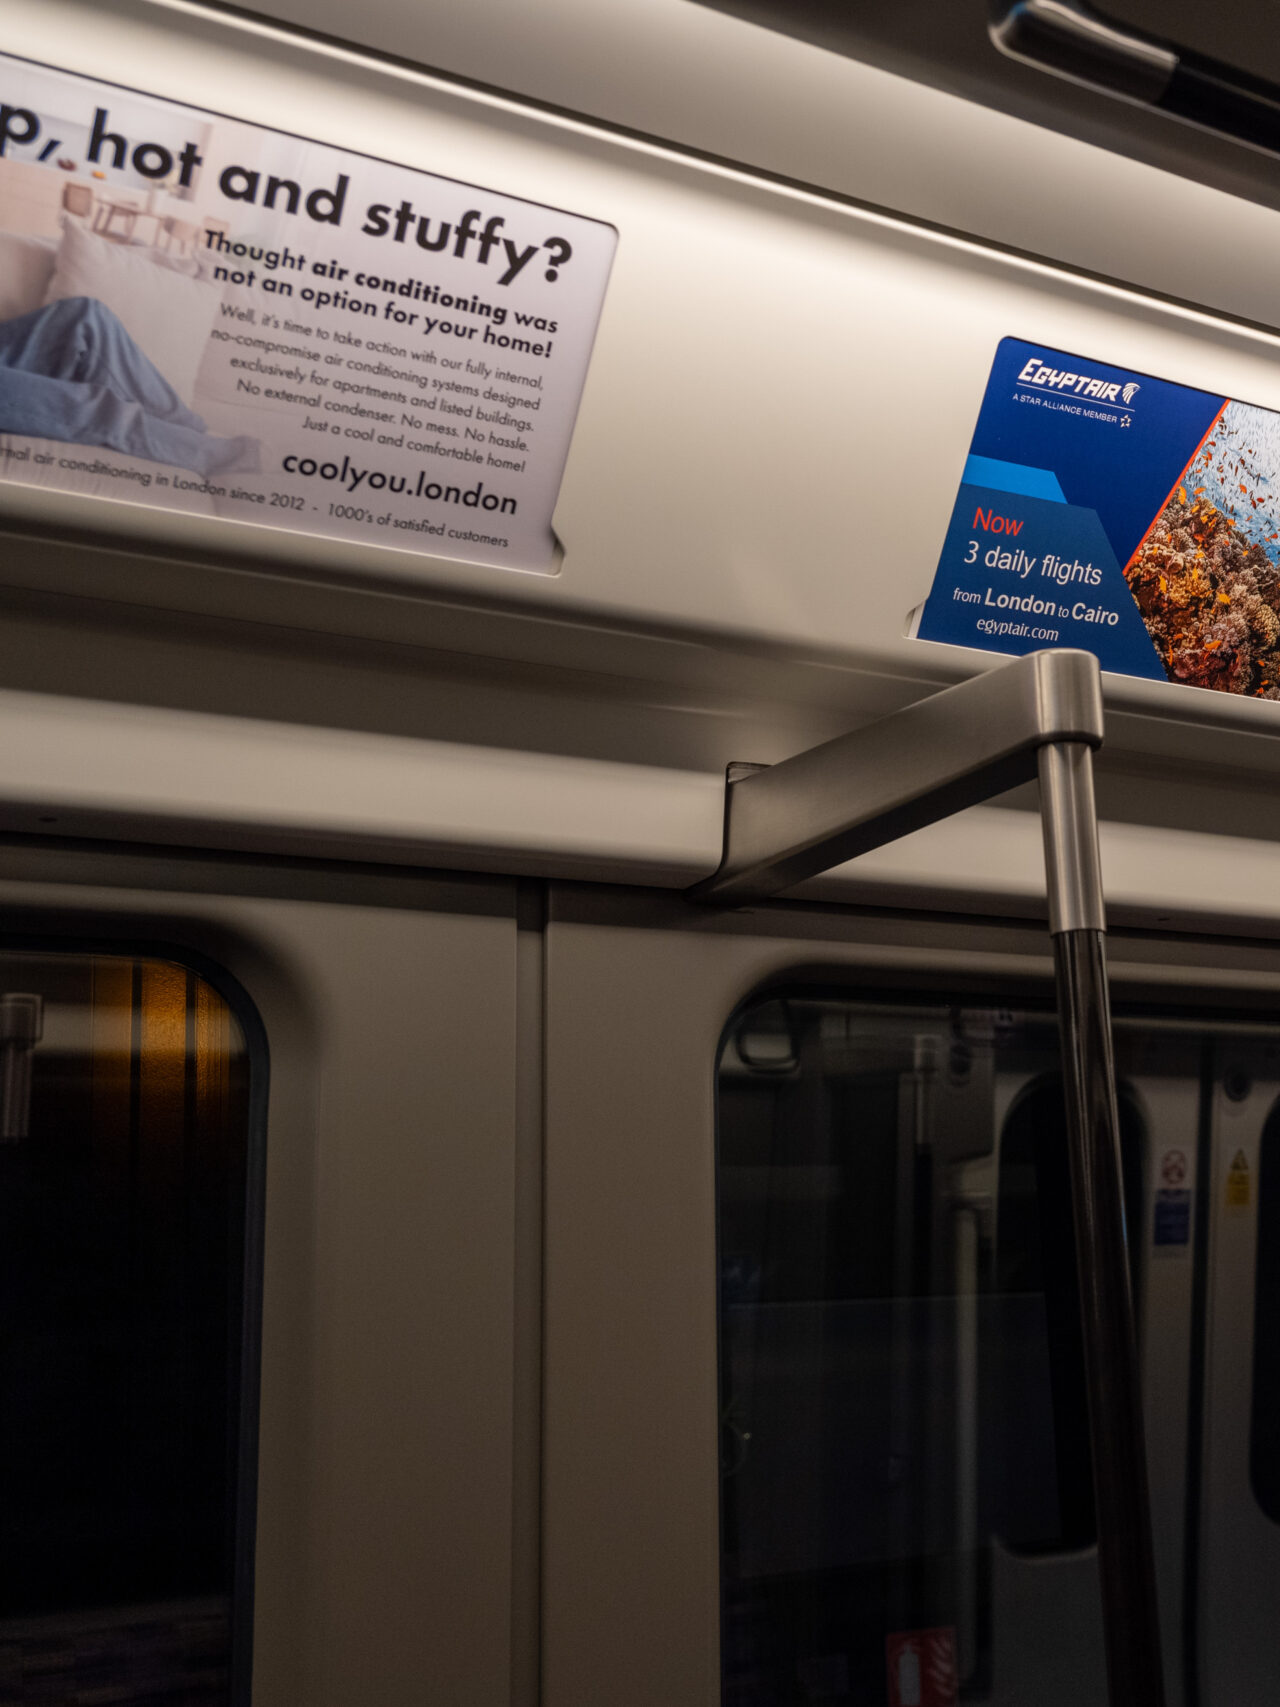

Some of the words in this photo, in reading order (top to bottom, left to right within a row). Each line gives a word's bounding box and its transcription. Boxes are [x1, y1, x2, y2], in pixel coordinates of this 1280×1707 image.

[87, 107, 203, 187] hot
[219, 164, 350, 226] and
[361, 200, 573, 287] stuffy?
[205, 229, 307, 270] Thought
[312, 260, 349, 280] air
[354, 272, 507, 326] conditioning
[515, 311, 558, 334] was
[213, 266, 256, 287] not
[262, 278, 293, 297] an
[300, 288, 377, 317] option
[384, 301, 419, 326] for
[423, 317, 478, 340] your
[483, 325, 553, 358] home!
[210, 328, 321, 362] no-compromise
[324, 354, 343, 366] air
[346, 359, 428, 389] conditioning
[431, 377, 480, 398] systems
[482, 387, 541, 410] designed
[220, 303, 256, 325] Well,
[283, 319, 313, 337] time
[316, 326, 330, 341] to
[333, 331, 363, 348] take
[365, 340, 407, 358] action
[411, 350, 437, 365] with
[440, 357, 463, 370] our
[466, 359, 492, 379] fully
[494, 368, 544, 391] internal,
[1017, 358, 1122, 402] EGYPTAIR
[230, 357, 306, 384] exclusively
[309, 370, 330, 386] for
[332, 379, 407, 404] apartments
[410, 397, 437, 410] and
[440, 399, 473, 418] listed
[476, 406, 534, 432] buildings.
[236, 378, 261, 395] No
[264, 388, 322, 408] external
[324, 400, 396, 424] condenser.
[401, 414, 423, 429] No
[426, 422, 460, 438] mess.
[464, 427, 485, 442] No
[488, 431, 530, 452] hassle.
[1012, 393, 1019, 401] A
[1019, 394, 1042, 406] STAR
[1042, 400, 1082, 415] ALLIANCE
[1082, 409, 1118, 424] MEMBER
[302, 416, 328, 432] Just
[331, 425, 341, 435] a
[344, 428, 375, 442] cool
[377, 434, 405, 448] and
[407, 440, 483, 464] comfortable
[33, 452, 57, 465] air
[58, 457, 152, 487] conditioning
[155, 472, 169, 486] in
[173, 475, 226, 497] London
[229, 487, 266, 504] since
[270, 492, 305, 511] 2012
[328, 503, 373, 524] 1000's
[376, 512, 392, 526] of
[393, 518, 446, 536] satisfied
[448, 528, 509, 548] customers
[282, 455, 518, 515] coolyou.london
[972, 506, 1024, 537] Now
[964, 540, 979, 564] 3
[984, 545, 1036, 579] daily
[1040, 554, 1103, 586] flights
[952, 587, 981, 604] from
[984, 588, 1056, 617] London
[1058, 605, 1070, 618] to
[1072, 602, 1119, 626] Cairo
[976, 618, 1059, 642] egyptair.com
